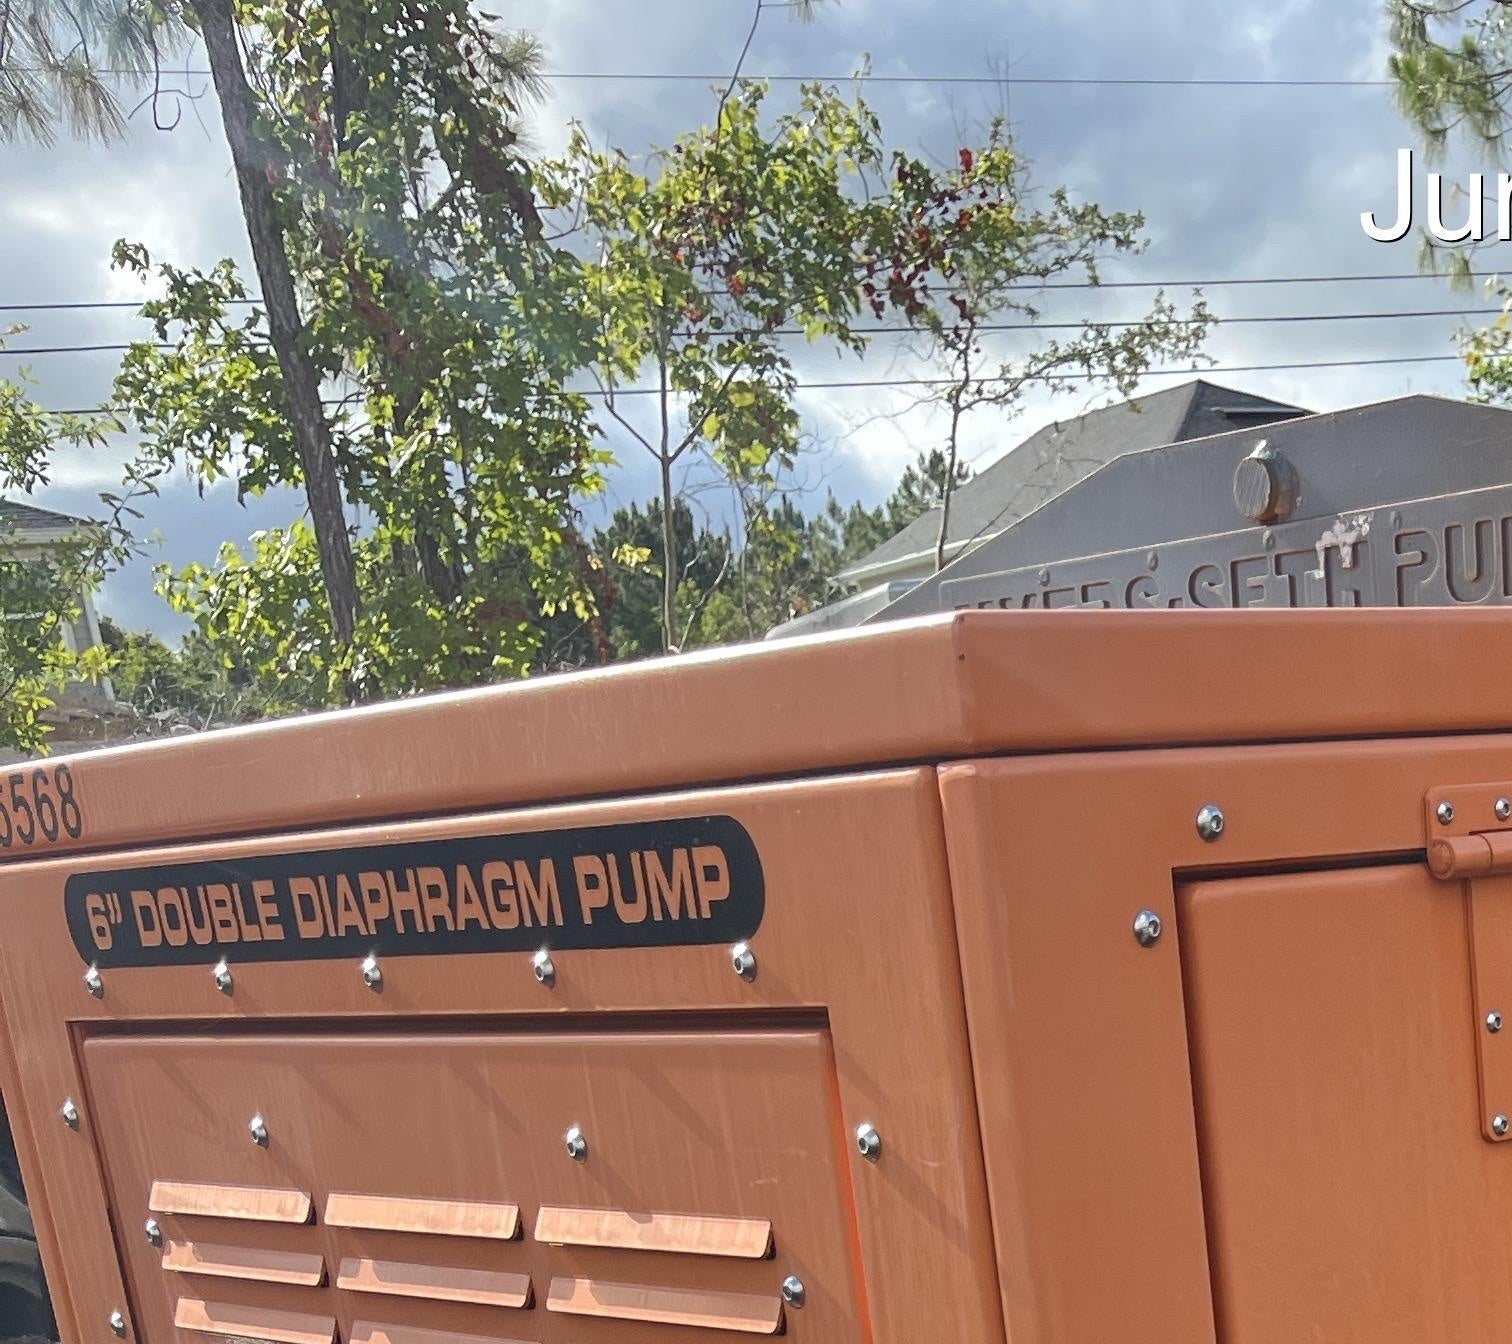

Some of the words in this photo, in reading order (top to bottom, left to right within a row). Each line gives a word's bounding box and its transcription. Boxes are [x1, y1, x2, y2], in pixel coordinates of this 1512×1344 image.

[129, 878, 286, 948] DOUBLE
[287, 856, 565, 940] DIAPHRAGM
[572, 844, 731, 926] PUMP
